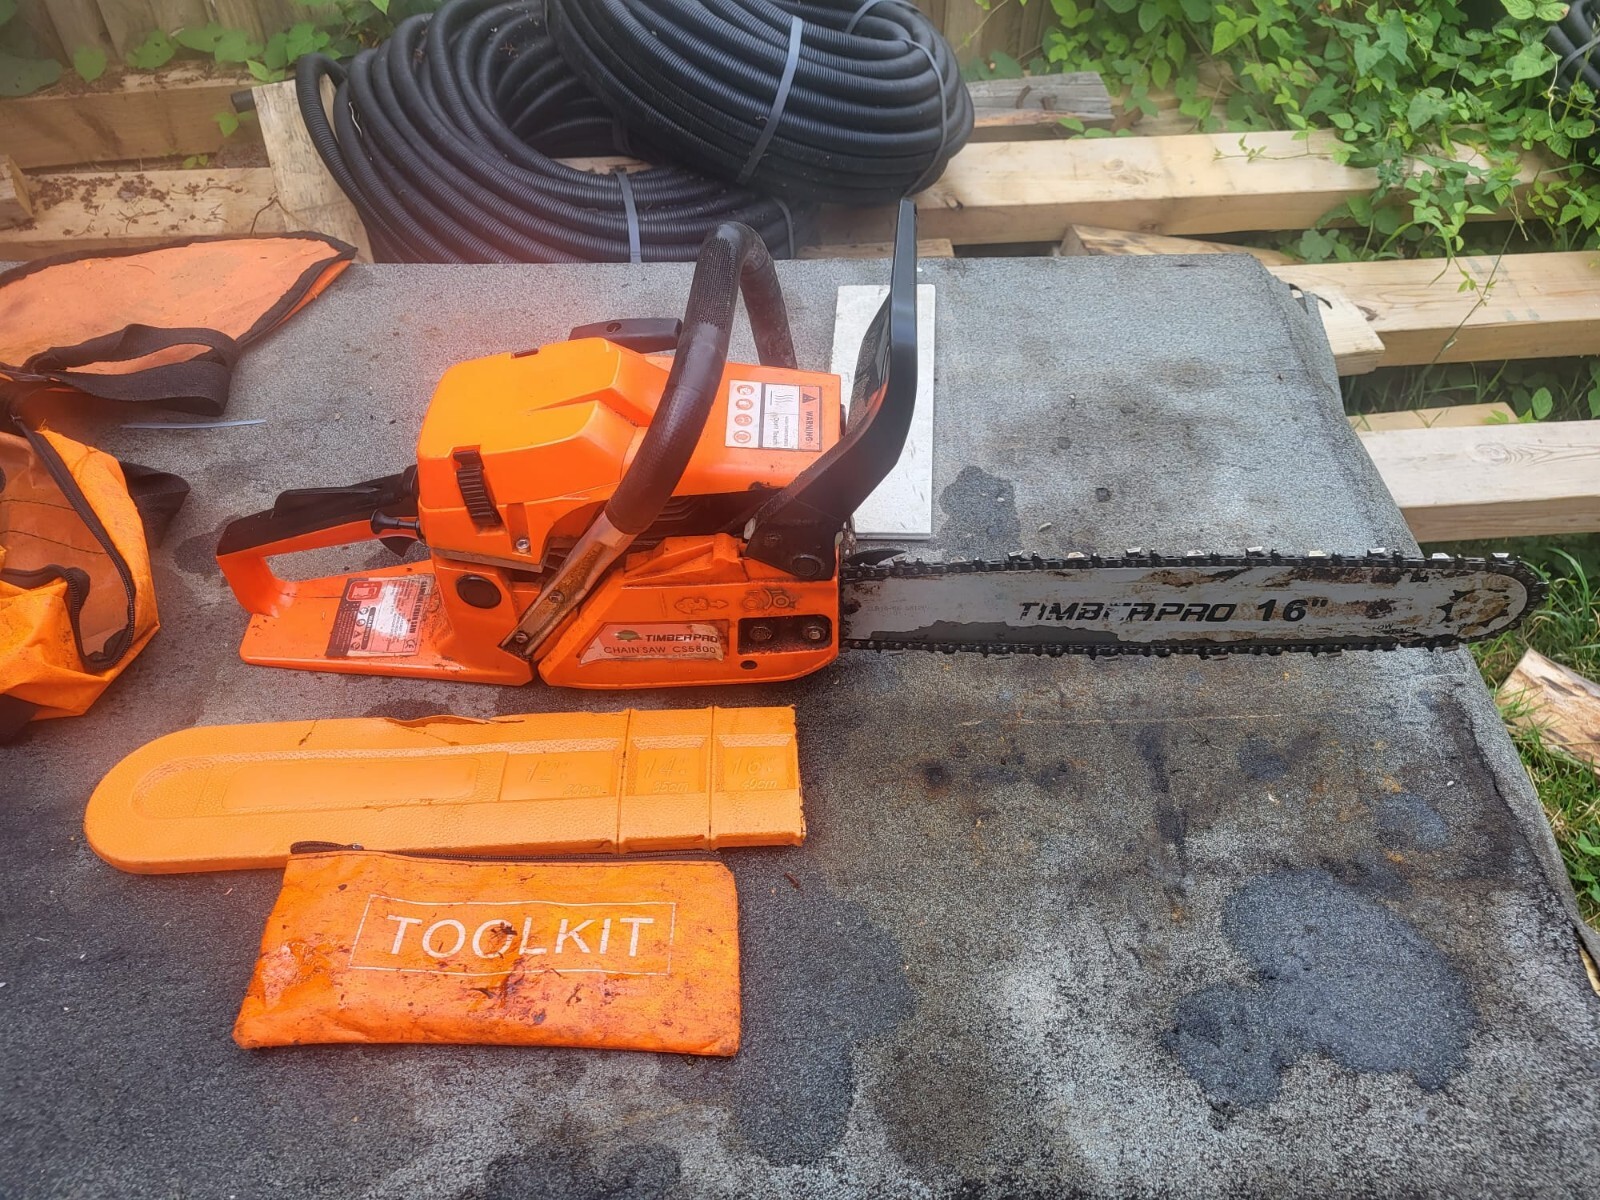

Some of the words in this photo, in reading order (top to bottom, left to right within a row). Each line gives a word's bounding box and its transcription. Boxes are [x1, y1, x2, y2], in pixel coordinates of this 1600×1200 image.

[1256, 599, 1329, 622] 16"
[645, 633, 718, 644] TIMBERPRO
[603, 646, 640, 654] CHAIN
[643, 646, 667, 654] SAW
[672, 645, 717, 654] CS5800
[386, 914, 654, 959] TOOLKIT
